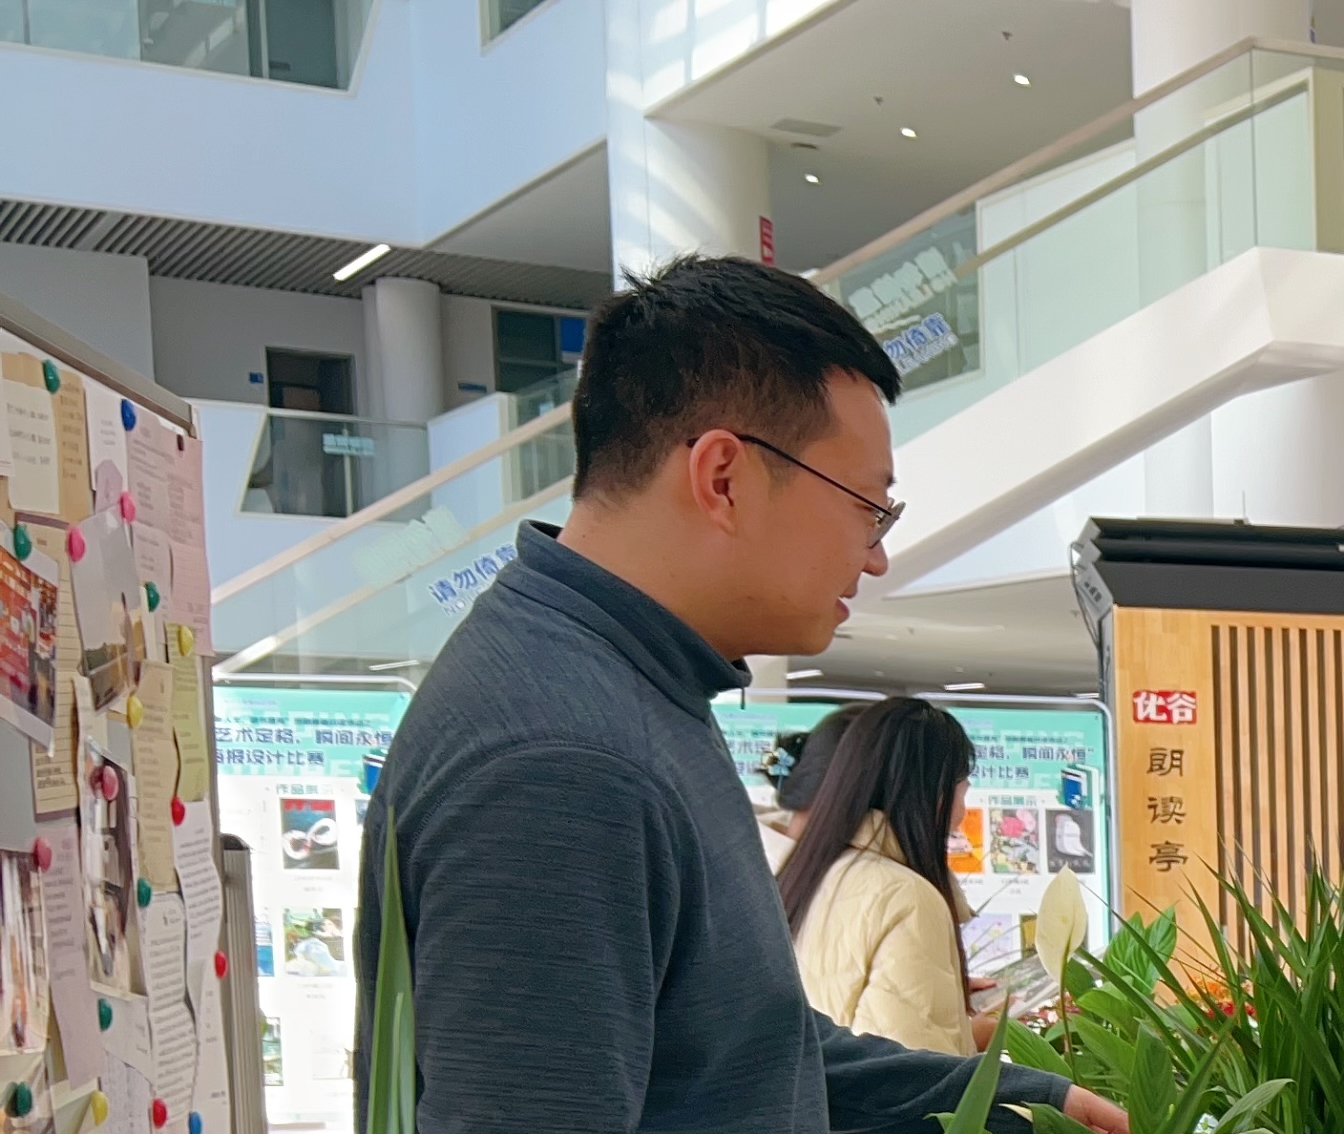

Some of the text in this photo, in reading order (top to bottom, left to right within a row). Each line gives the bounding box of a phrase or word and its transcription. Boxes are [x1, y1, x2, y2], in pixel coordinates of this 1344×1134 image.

[1133, 691, 1196, 723] 优谷
[1146, 748, 1189, 872] 朗读亭
